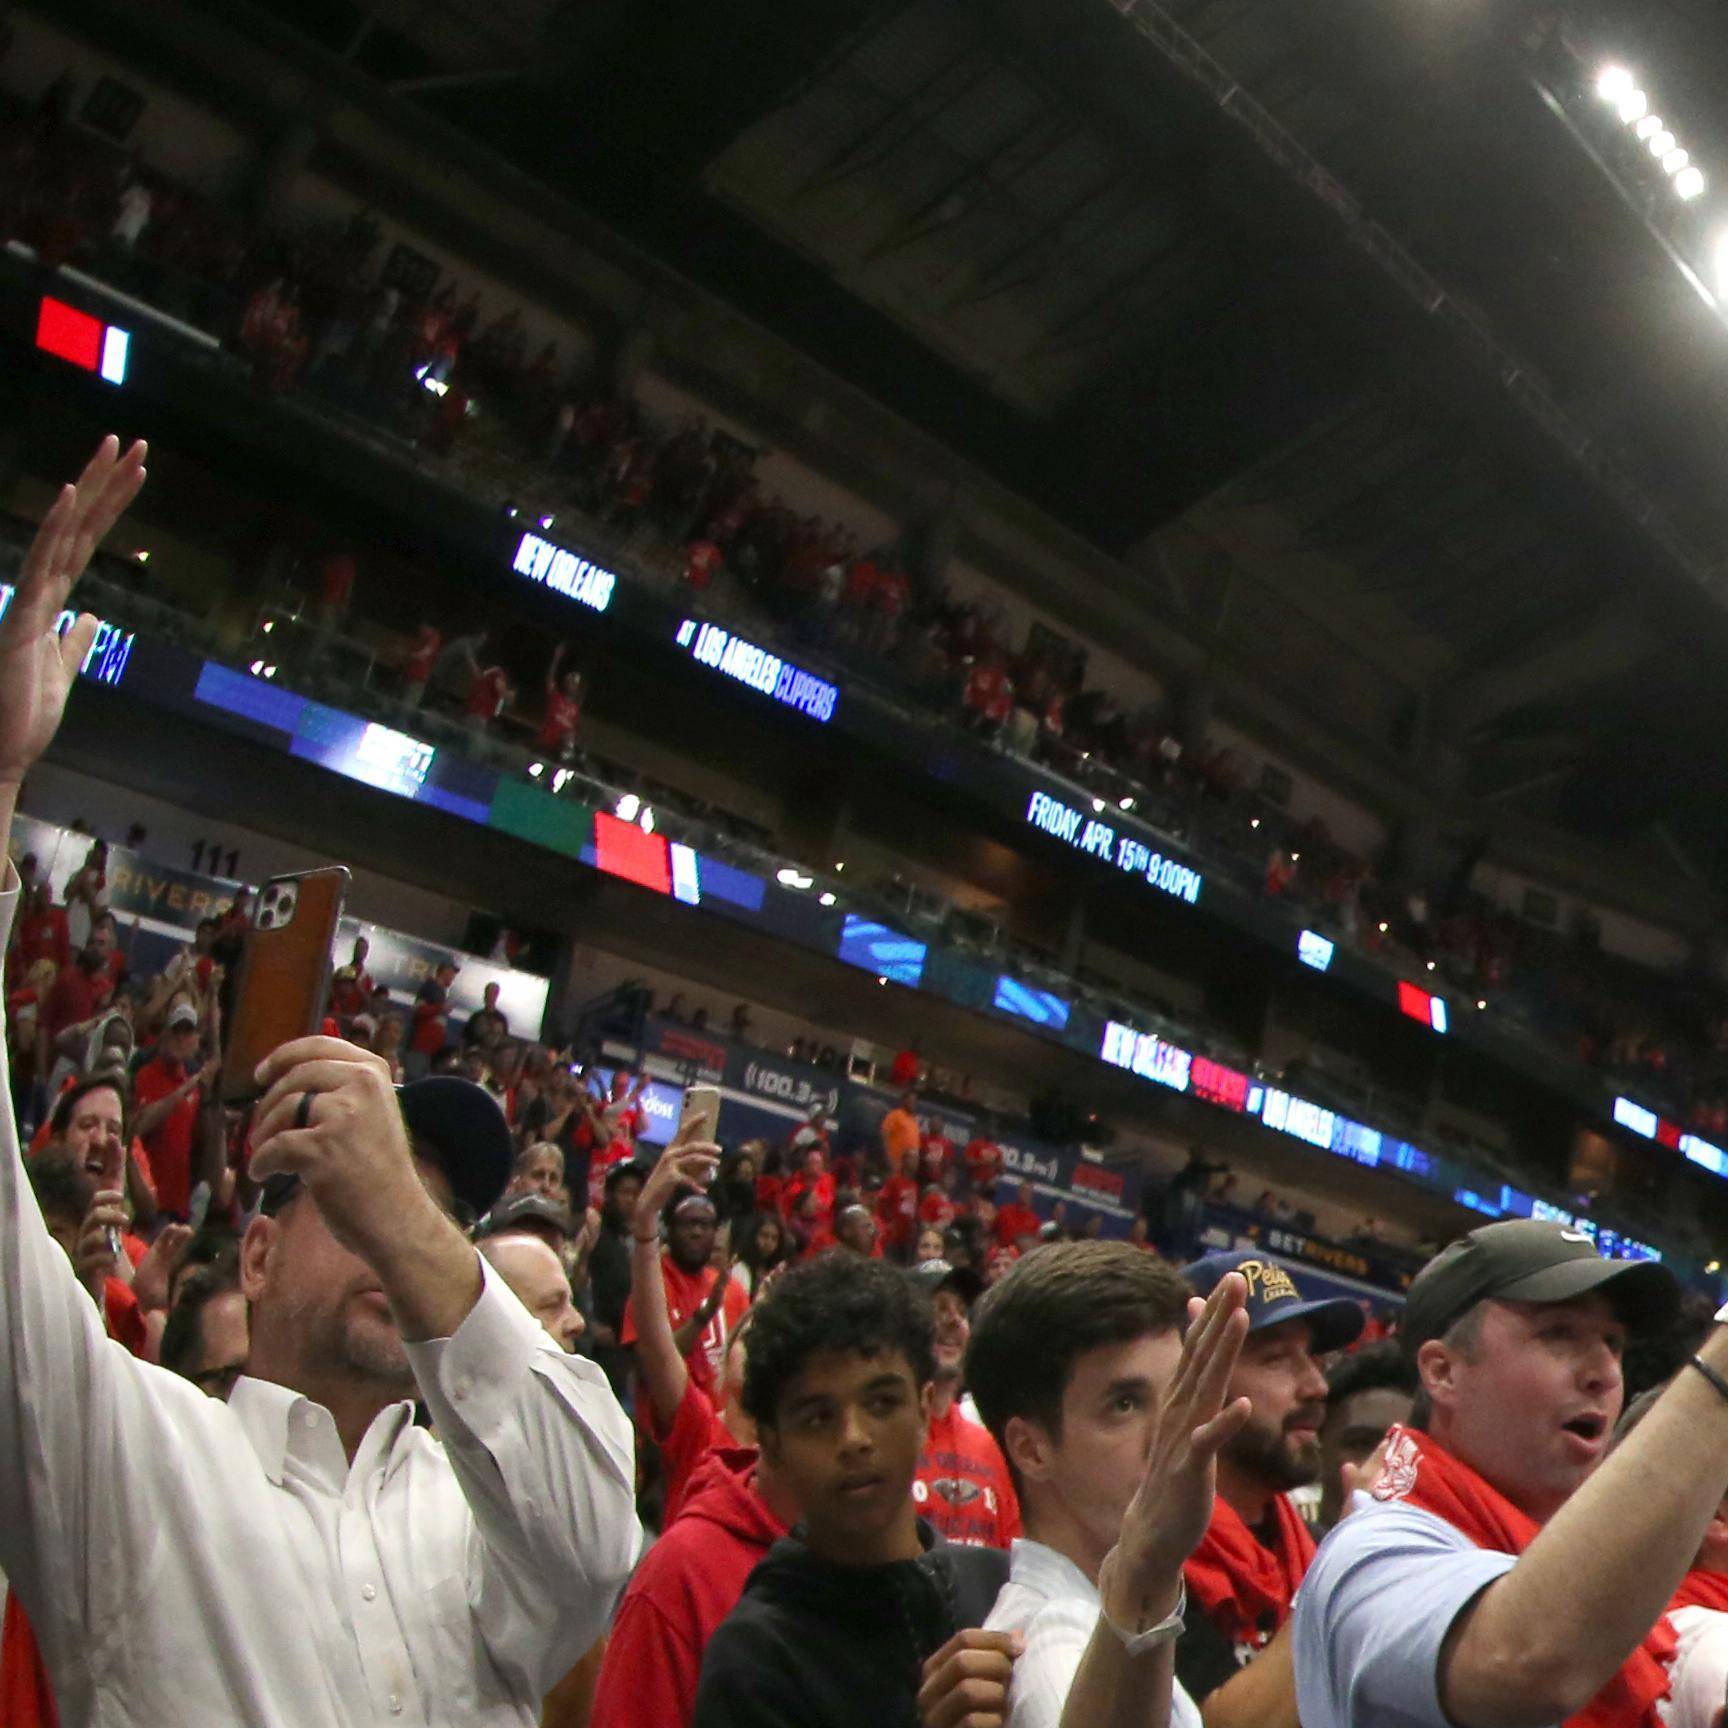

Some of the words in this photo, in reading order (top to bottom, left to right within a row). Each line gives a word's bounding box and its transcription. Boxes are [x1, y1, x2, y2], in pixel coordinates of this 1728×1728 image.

[512, 531, 556, 583] NEW
[545, 548, 616, 612] ORLEANS
[692, 622, 728, 668] LOS
[719, 636, 781, 695] ANGELES
[774, 664, 838, 722] CLIPPERS
[1081, 820, 1115, 862] APR.
[1146, 852, 1202, 905] 9:00PM
